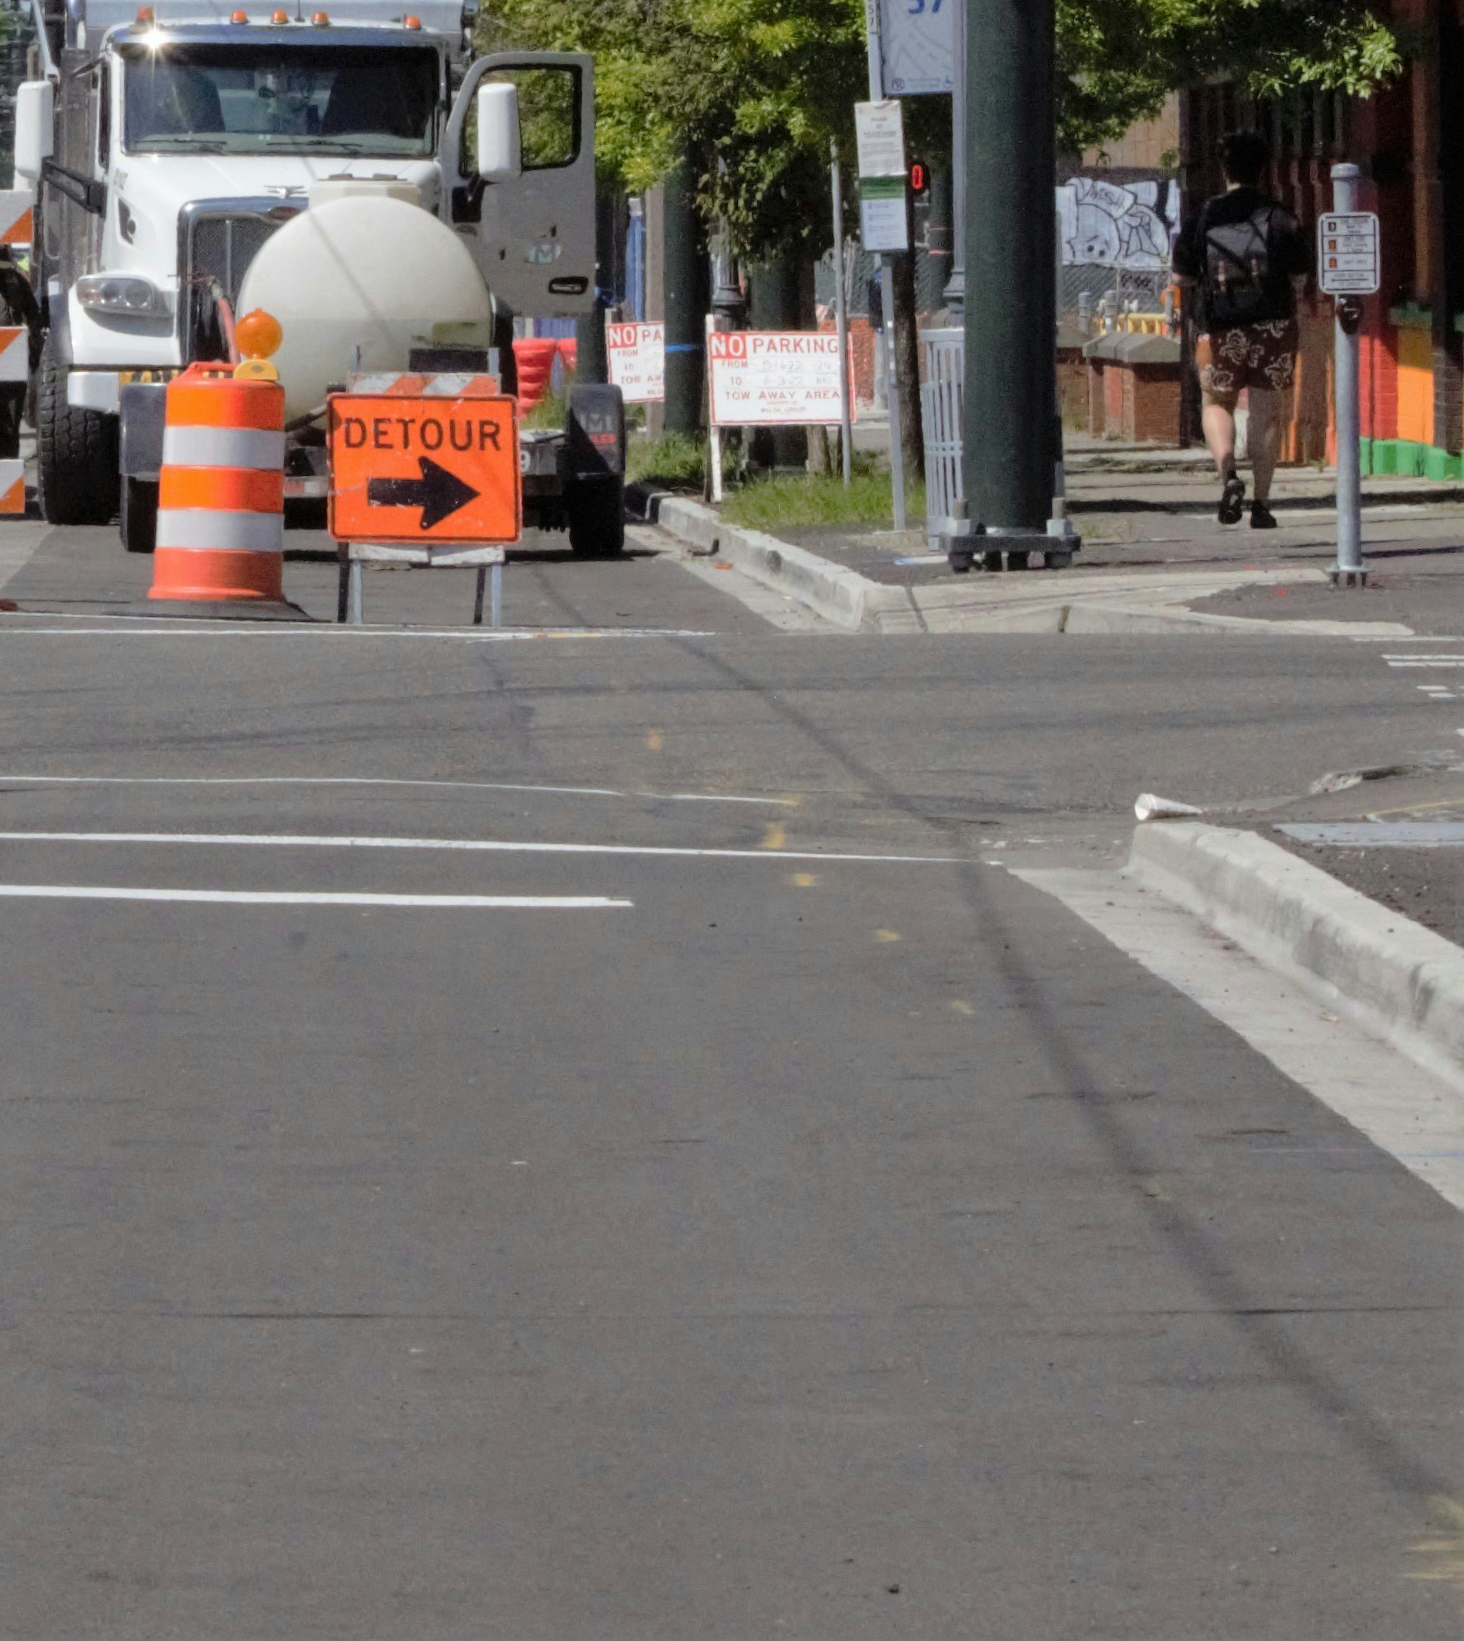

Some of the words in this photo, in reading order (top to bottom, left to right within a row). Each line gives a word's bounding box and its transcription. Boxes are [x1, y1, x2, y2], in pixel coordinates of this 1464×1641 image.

[609, 327, 635, 346] NO
[711, 336, 744, 357] NO
[753, 338, 838, 354] PARKING
[758, 391, 796, 400] AWAY
[805, 391, 840, 400] AREA
[345, 417, 501, 452] DETOUR
